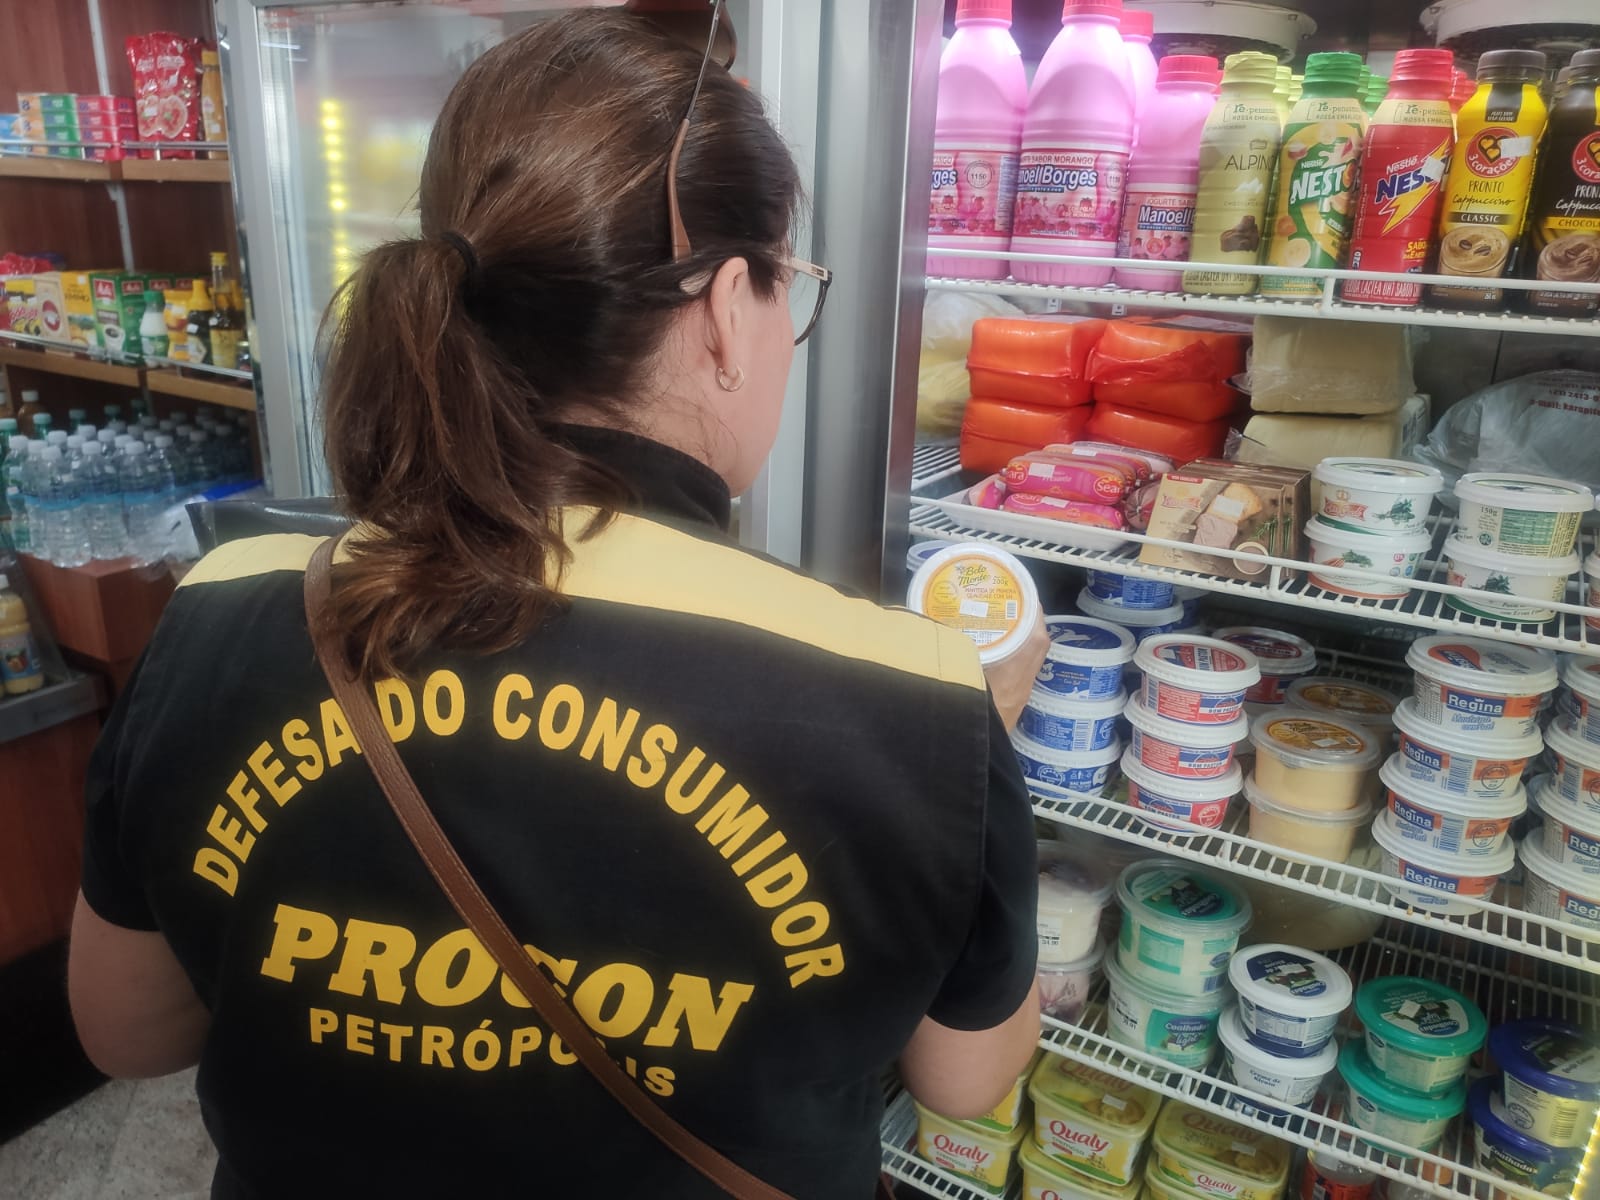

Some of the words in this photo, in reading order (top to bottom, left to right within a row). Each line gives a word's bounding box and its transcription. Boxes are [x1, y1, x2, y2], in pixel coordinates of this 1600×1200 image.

[1041, 166, 1097, 190] Borges
[1290, 164, 1347, 204] NEST
[1468, 181, 1505, 193] PRONTO
[1574, 185, 1600, 198] PRON
[1139, 206, 1189, 225] Manoel
[1460, 213, 1500, 223] CLASSIC
[1448, 694, 1503, 713] Regina
[1405, 741, 1440, 767] Regina
[1394, 801, 1432, 826] Regina
[193, 698, 365, 897] DEFESA
[374, 669, 466, 743] DO
[492, 673, 846, 989] CONSUMIDOR
[1570, 835, 1600, 856] Reg
[1405, 868, 1456, 890] Regina
[309, 1007, 676, 1098] PETRÓPOIS
[1049, 1119, 1110, 1152] Qualy
[933, 1134, 990, 1164] Qualy
[1196, 1174, 1238, 1193] Qualy
